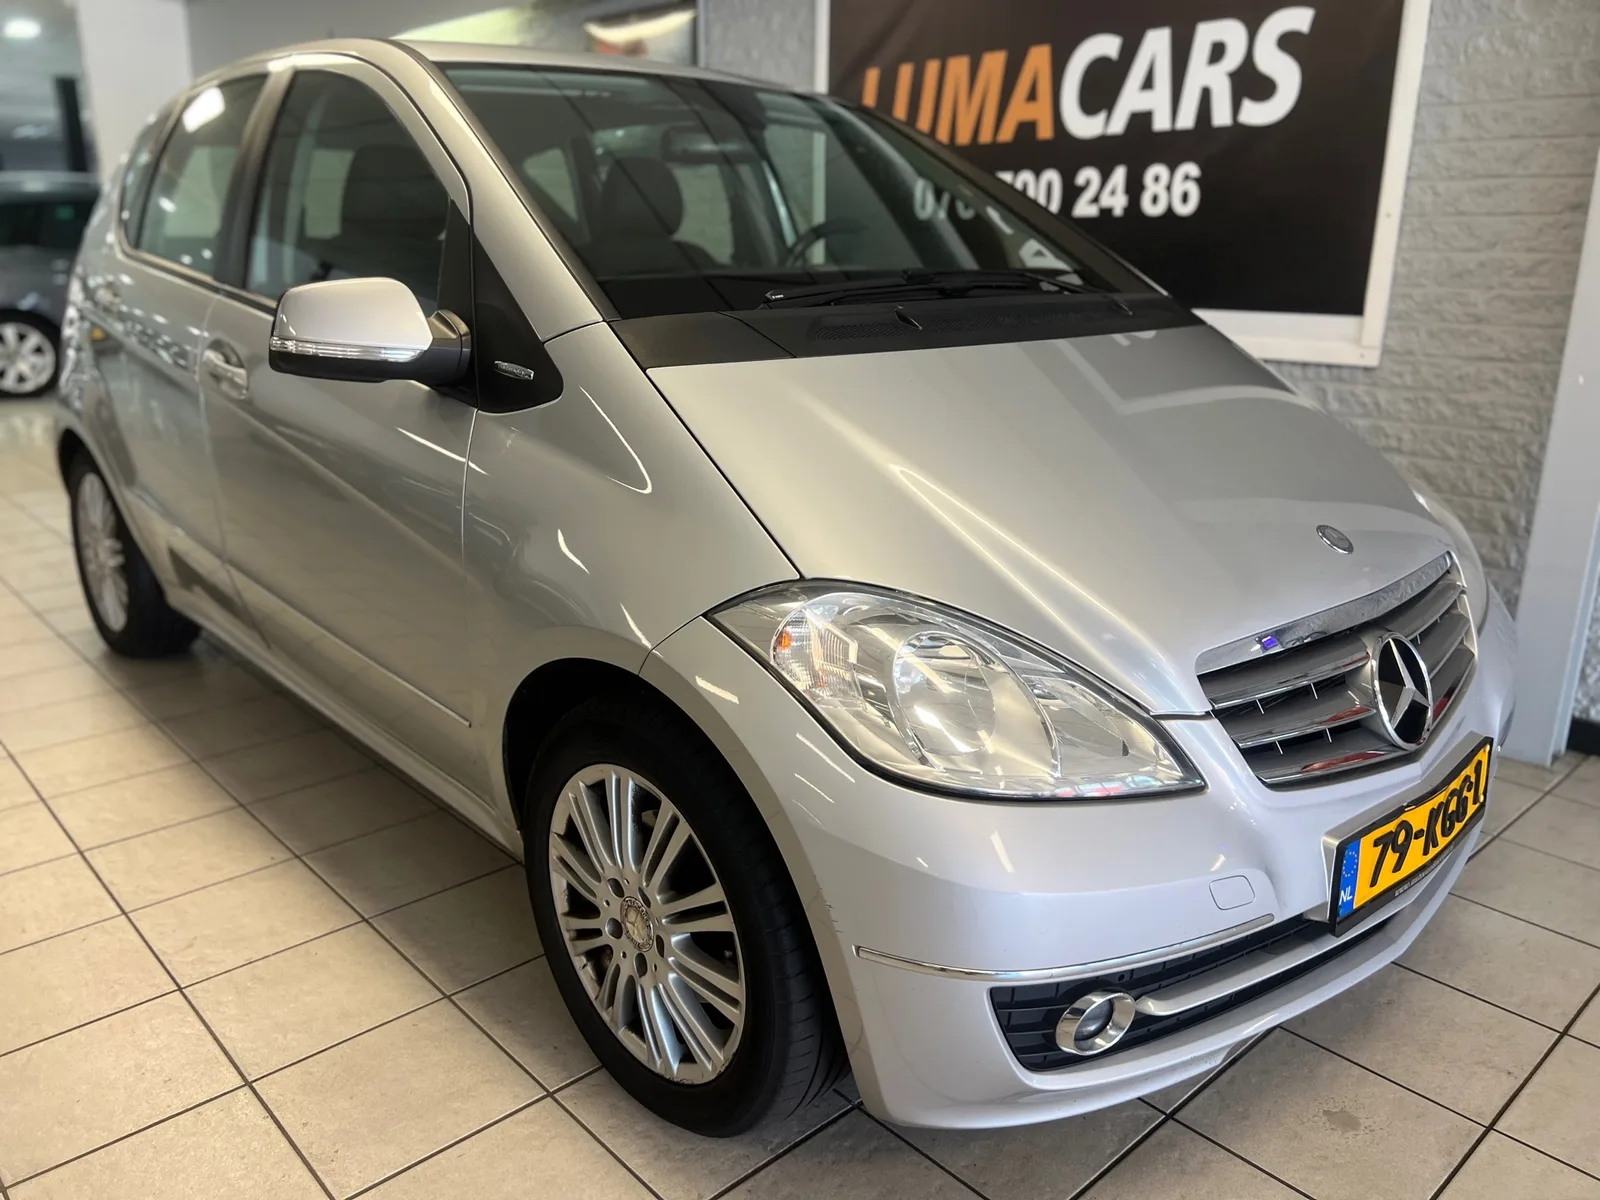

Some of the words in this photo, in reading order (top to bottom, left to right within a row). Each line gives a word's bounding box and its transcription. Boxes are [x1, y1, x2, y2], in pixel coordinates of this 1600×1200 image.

[1071, 165, 1128, 218] 24
[1140, 162, 1201, 217] 86
[1339, 885, 1353, 906] NL
